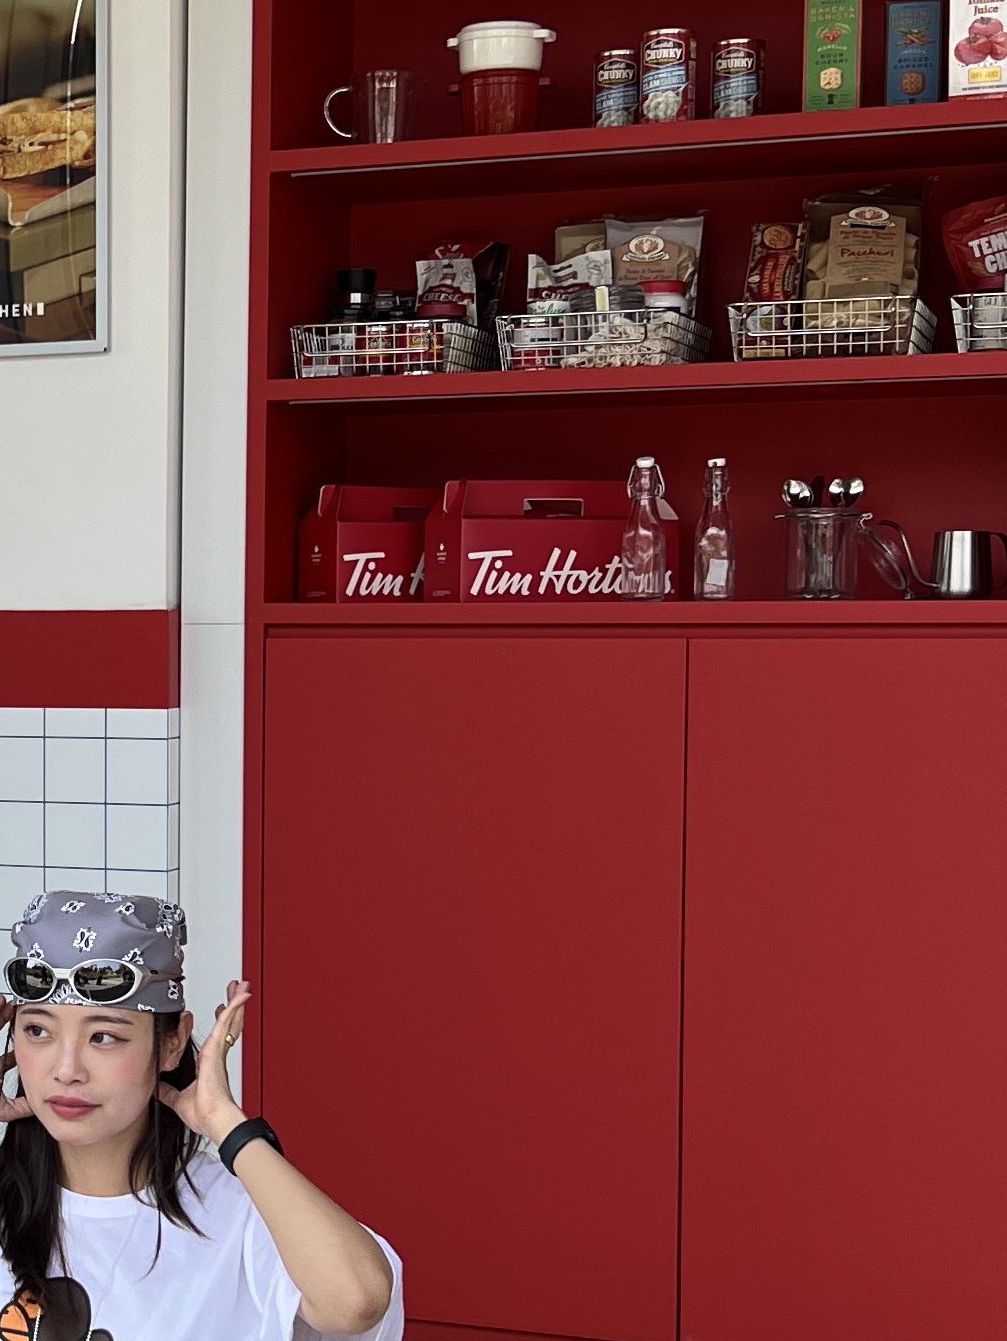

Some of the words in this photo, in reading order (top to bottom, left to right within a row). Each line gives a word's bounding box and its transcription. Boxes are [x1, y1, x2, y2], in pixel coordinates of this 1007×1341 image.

[973, 5, 999, 16] Juice
[645, 47, 683, 62] CHUNKY
[716, 56, 754, 71] CHUNKY
[598, 68, 634, 83] CHUNKY
[968, 231, 1007, 258] TEM
[984, 251, 1007, 274] CH
[423, 292, 461, 302] CHEESE
[343, 551, 404, 597] Tim
[467, 549, 533, 596] Tim
